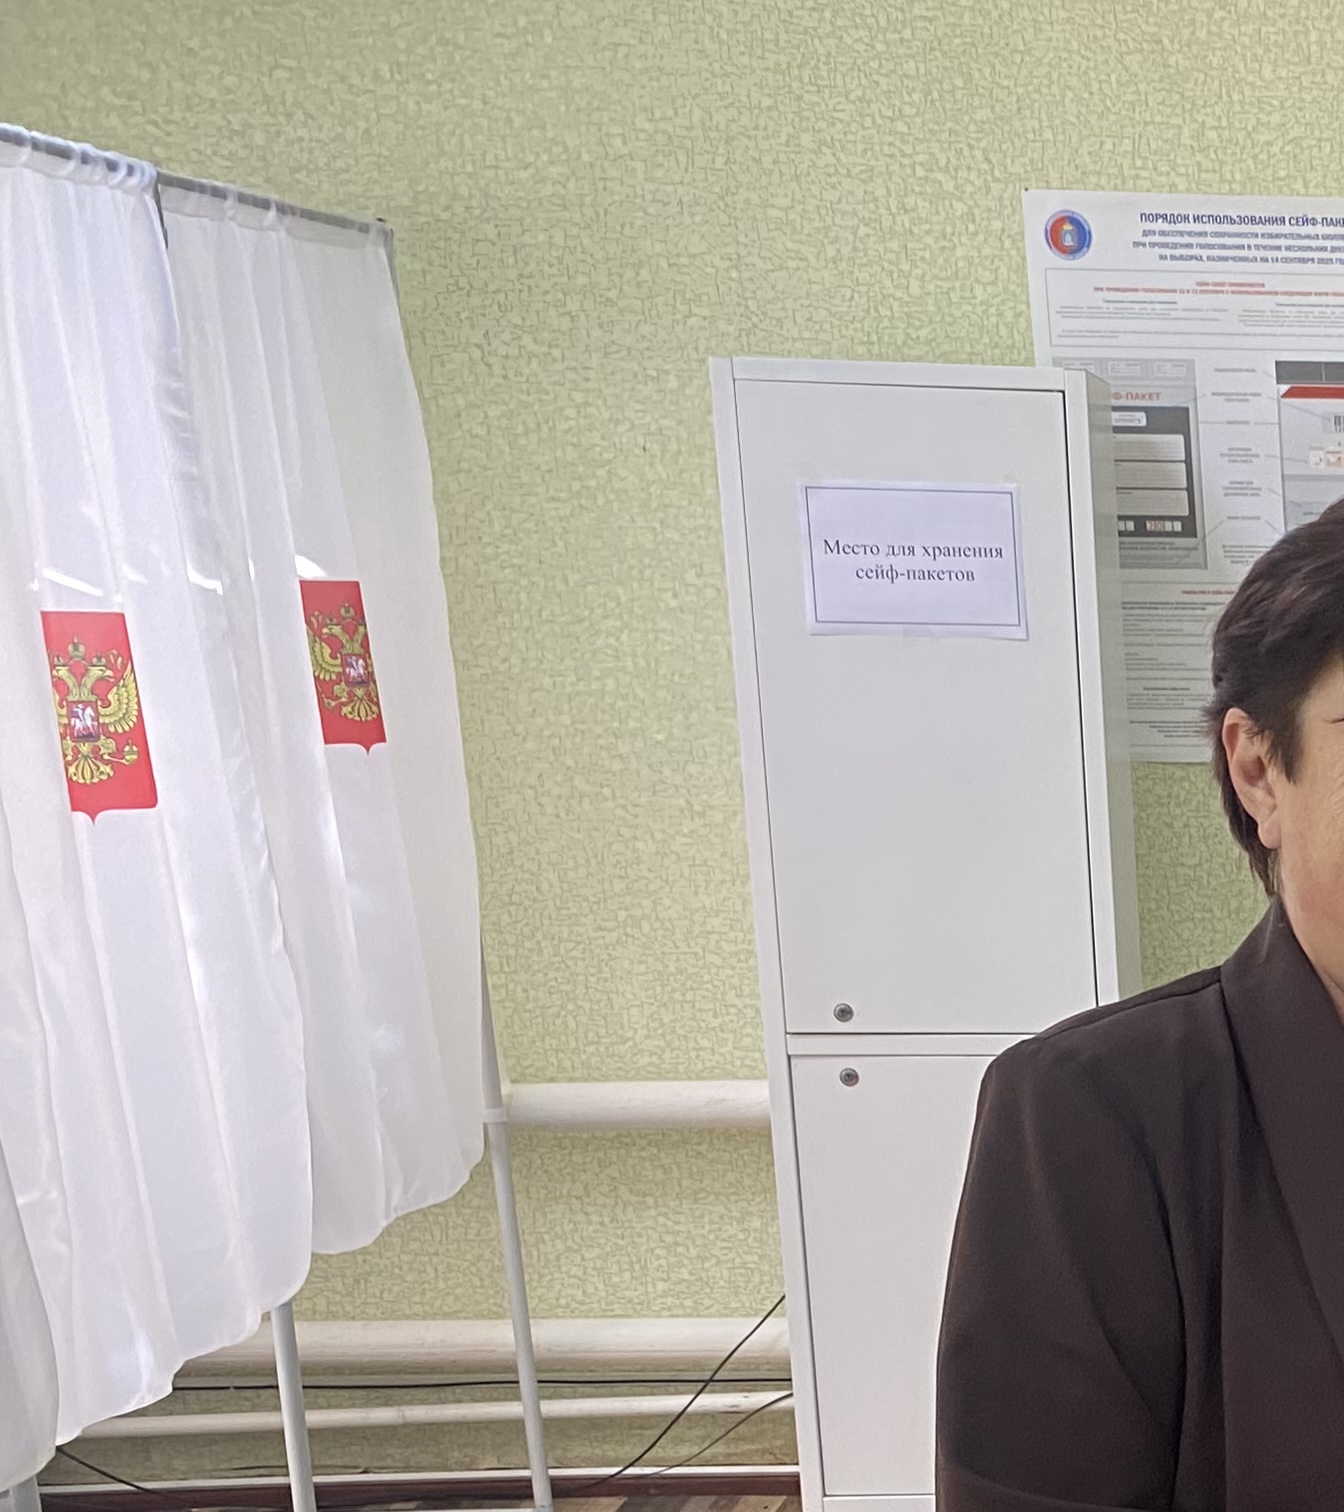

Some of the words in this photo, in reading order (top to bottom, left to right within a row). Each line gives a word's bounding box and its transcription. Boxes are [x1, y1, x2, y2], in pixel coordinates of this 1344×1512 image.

[1140, 213, 1190, 225] ПОРЯДОК
[1193, 214, 1286, 226] ИСПОЛЬЗОВАНИЯ
[1112, 392, 1162, 401] Ф-ПАКЕТ
[823, 539, 880, 556] Место
[885, 544, 916, 558] для
[922, 544, 1004, 561] хранения
[856, 564, 975, 584] сейф-пакетов
